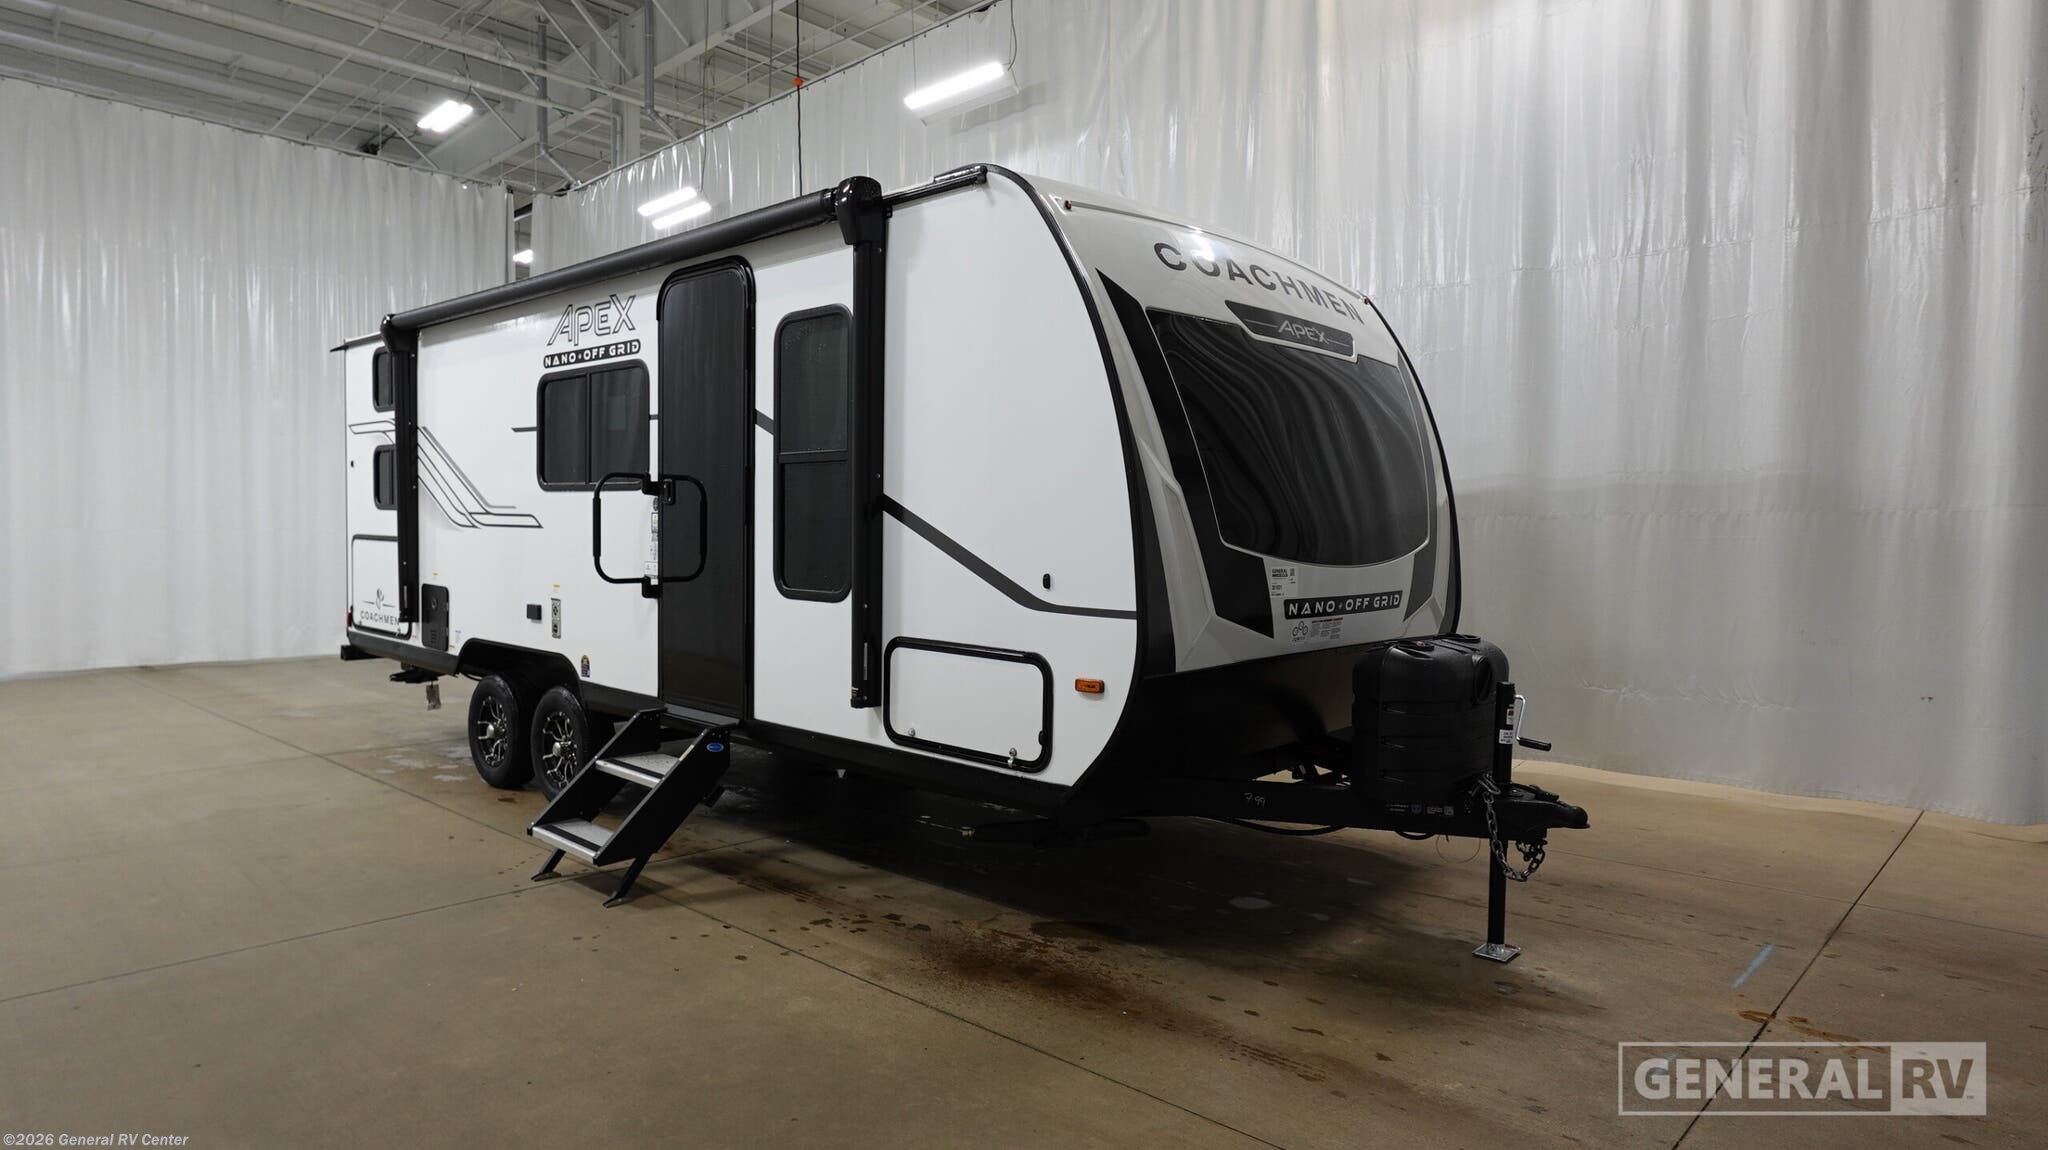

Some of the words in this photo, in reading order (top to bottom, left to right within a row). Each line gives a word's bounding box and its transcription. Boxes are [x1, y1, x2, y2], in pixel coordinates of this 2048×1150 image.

[546, 294, 636, 346] APEX
[1277, 320, 1329, 344] APEX
[545, 353, 576, 367] NANO
[583, 347, 605, 360] OFF
[609, 341, 639, 356] GRID
[1288, 600, 1336, 616] NANO
[1345, 598, 1370, 611] OFF
[1373, 594, 1400, 608] GRID
[360, 610, 400, 625] COACHMEN
